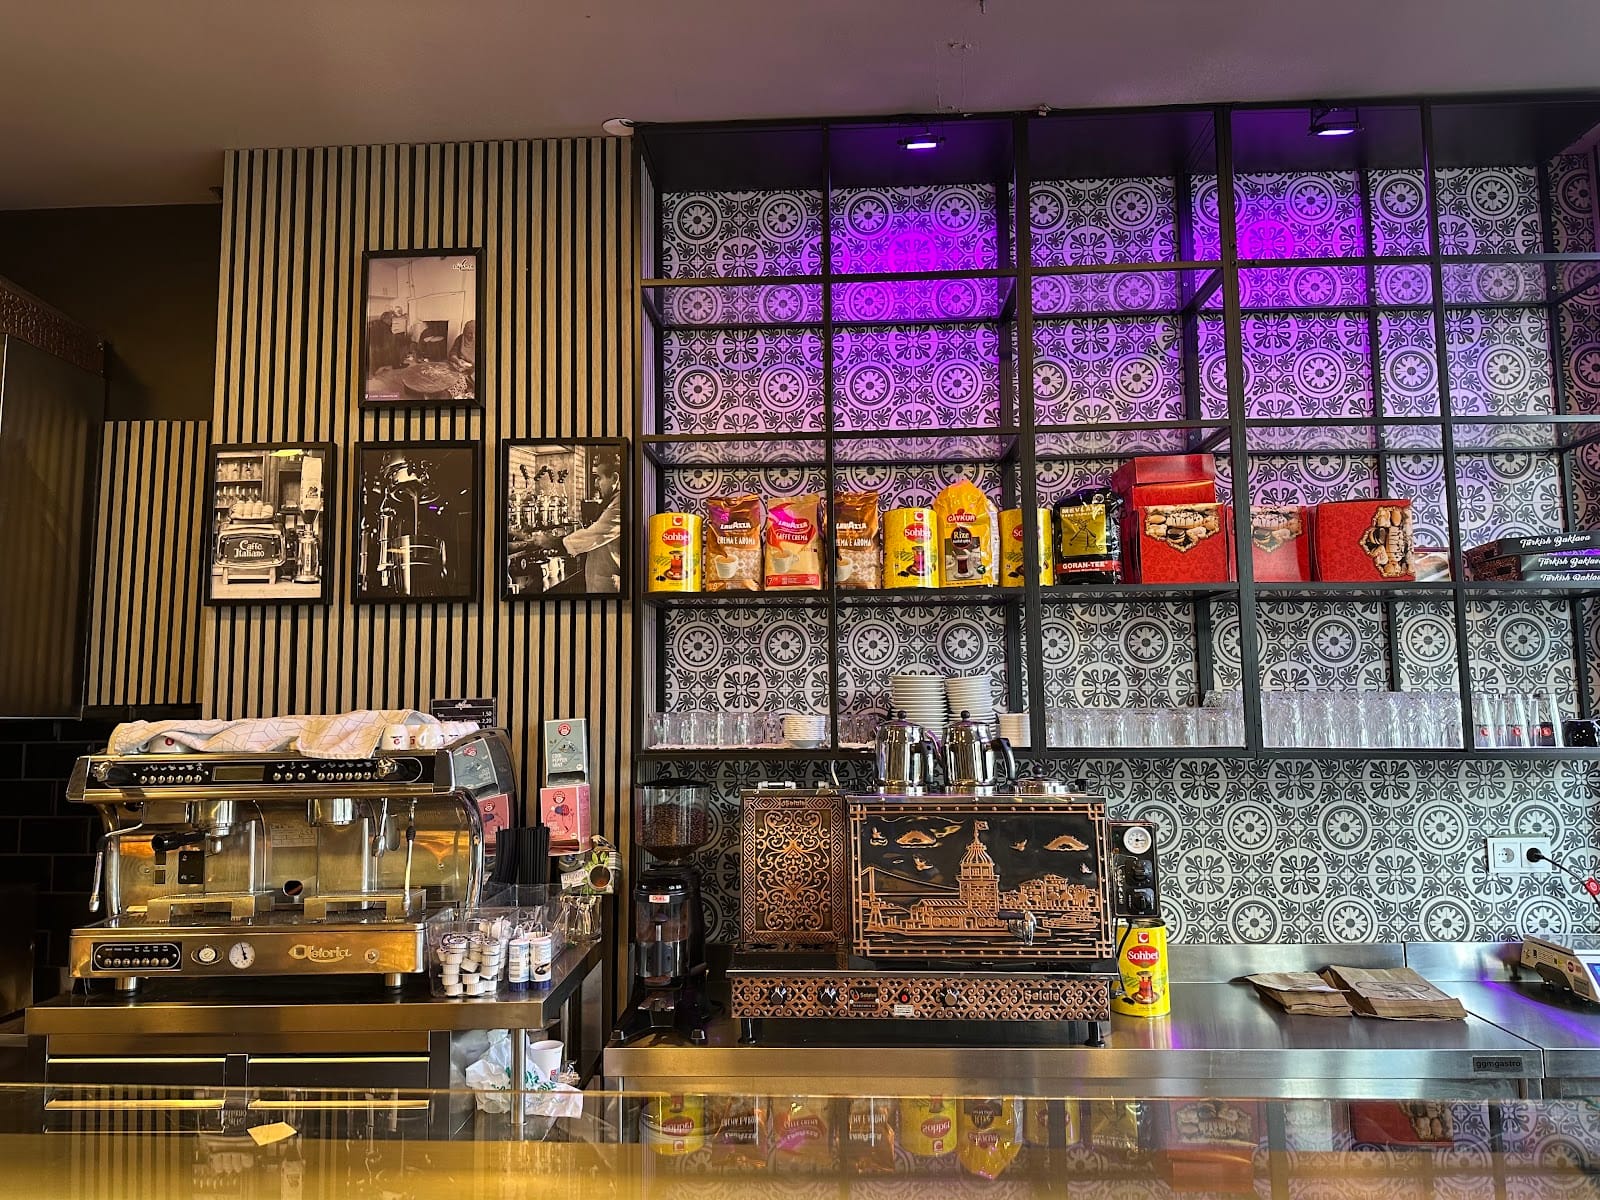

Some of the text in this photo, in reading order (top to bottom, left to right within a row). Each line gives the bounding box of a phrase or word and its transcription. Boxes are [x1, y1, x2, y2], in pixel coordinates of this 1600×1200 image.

[720, 521, 751, 529] LAVAZZA
[836, 538, 849, 547] EMA
[1570, 556, 1600, 568] Baklav
[1572, 573, 1600, 582] Baklav
[1128, 950, 1159, 960] Sohbet
